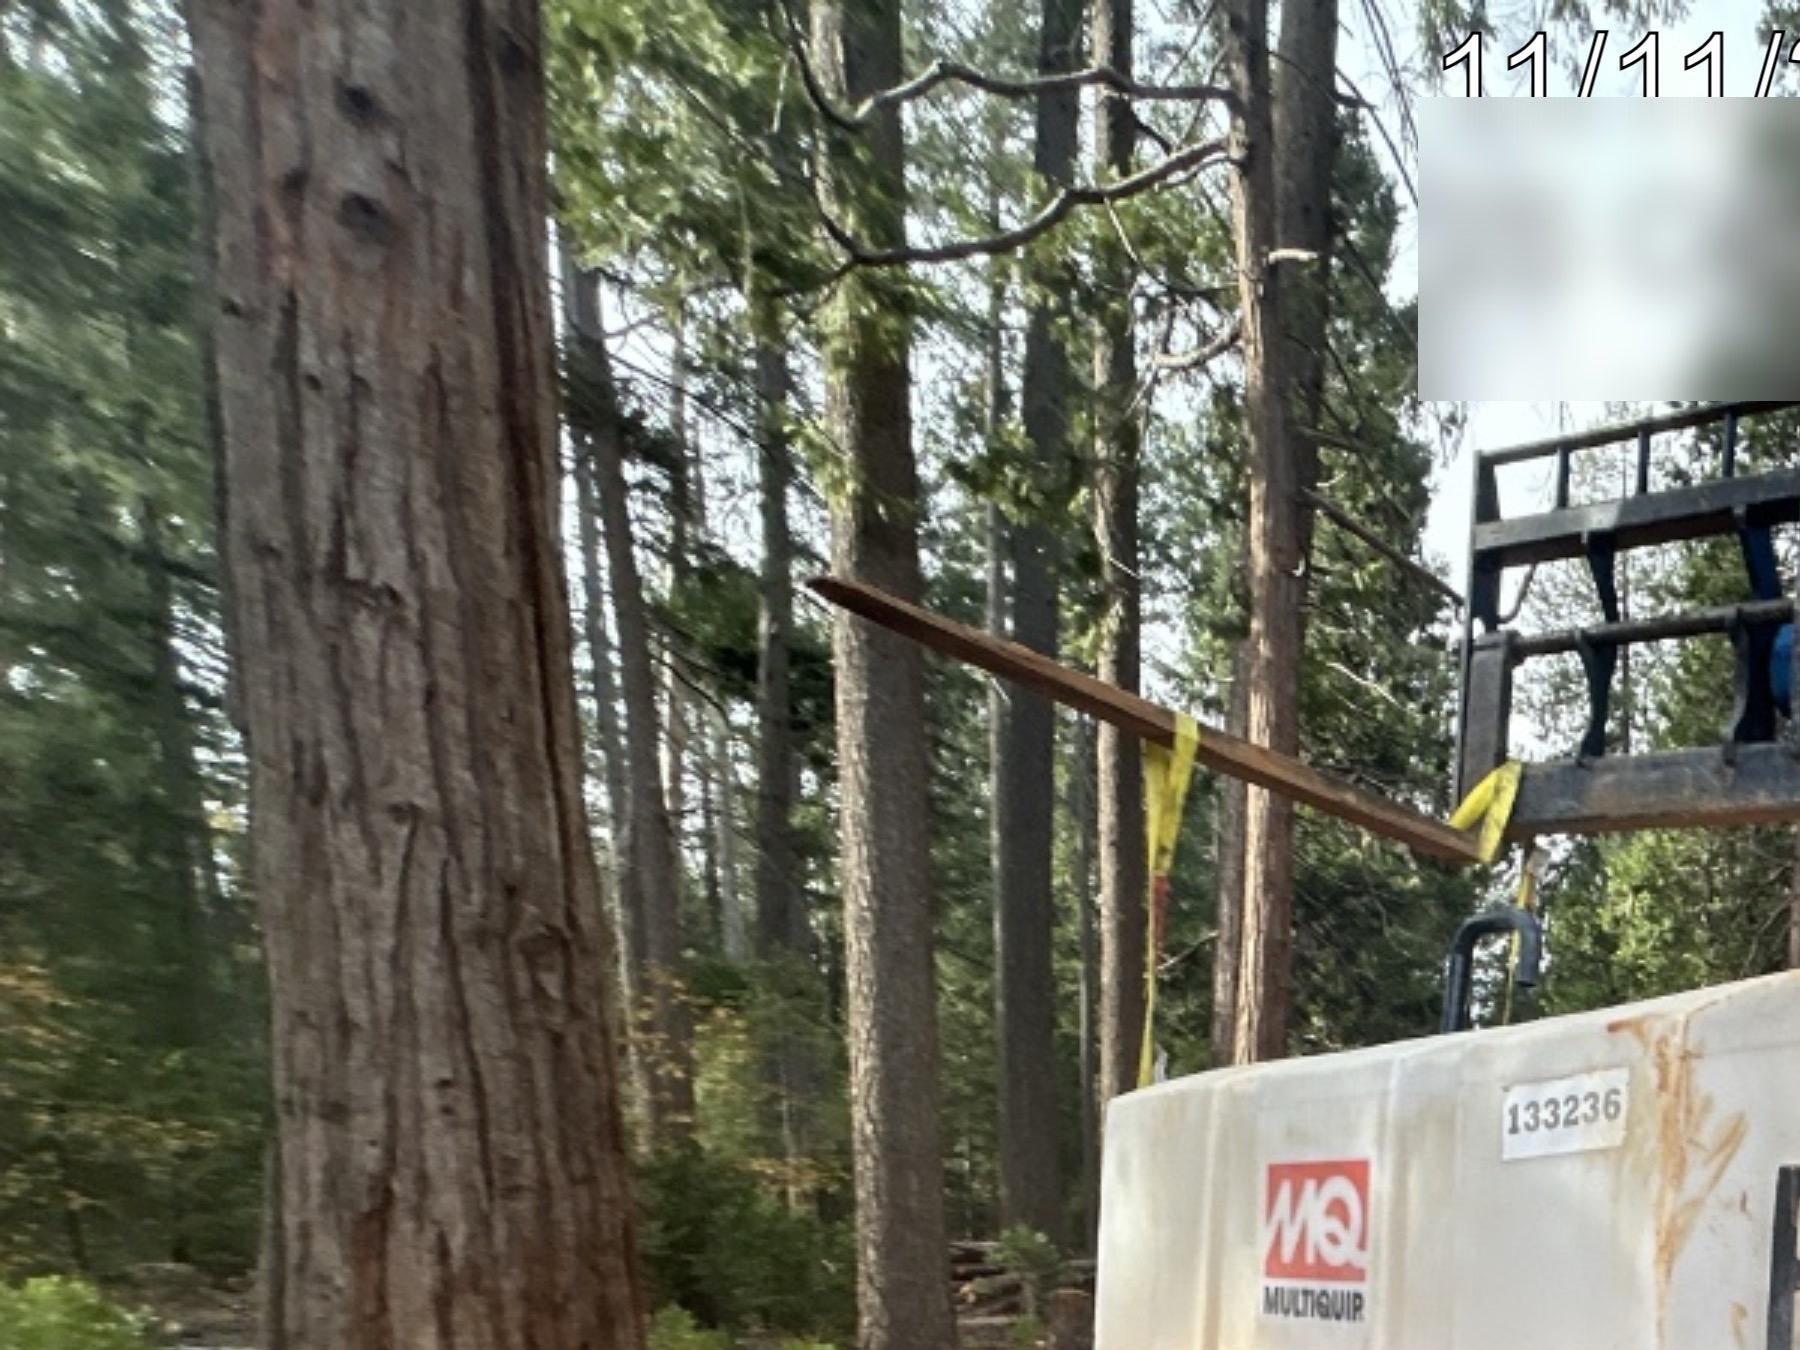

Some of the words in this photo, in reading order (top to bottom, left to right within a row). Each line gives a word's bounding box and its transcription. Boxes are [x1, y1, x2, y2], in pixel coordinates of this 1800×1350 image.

[1507, 1088, 1622, 1135] 133236
[1264, 1173, 1368, 1270] MQ
[1263, 1285, 1365, 1322] MULTIQUIP
